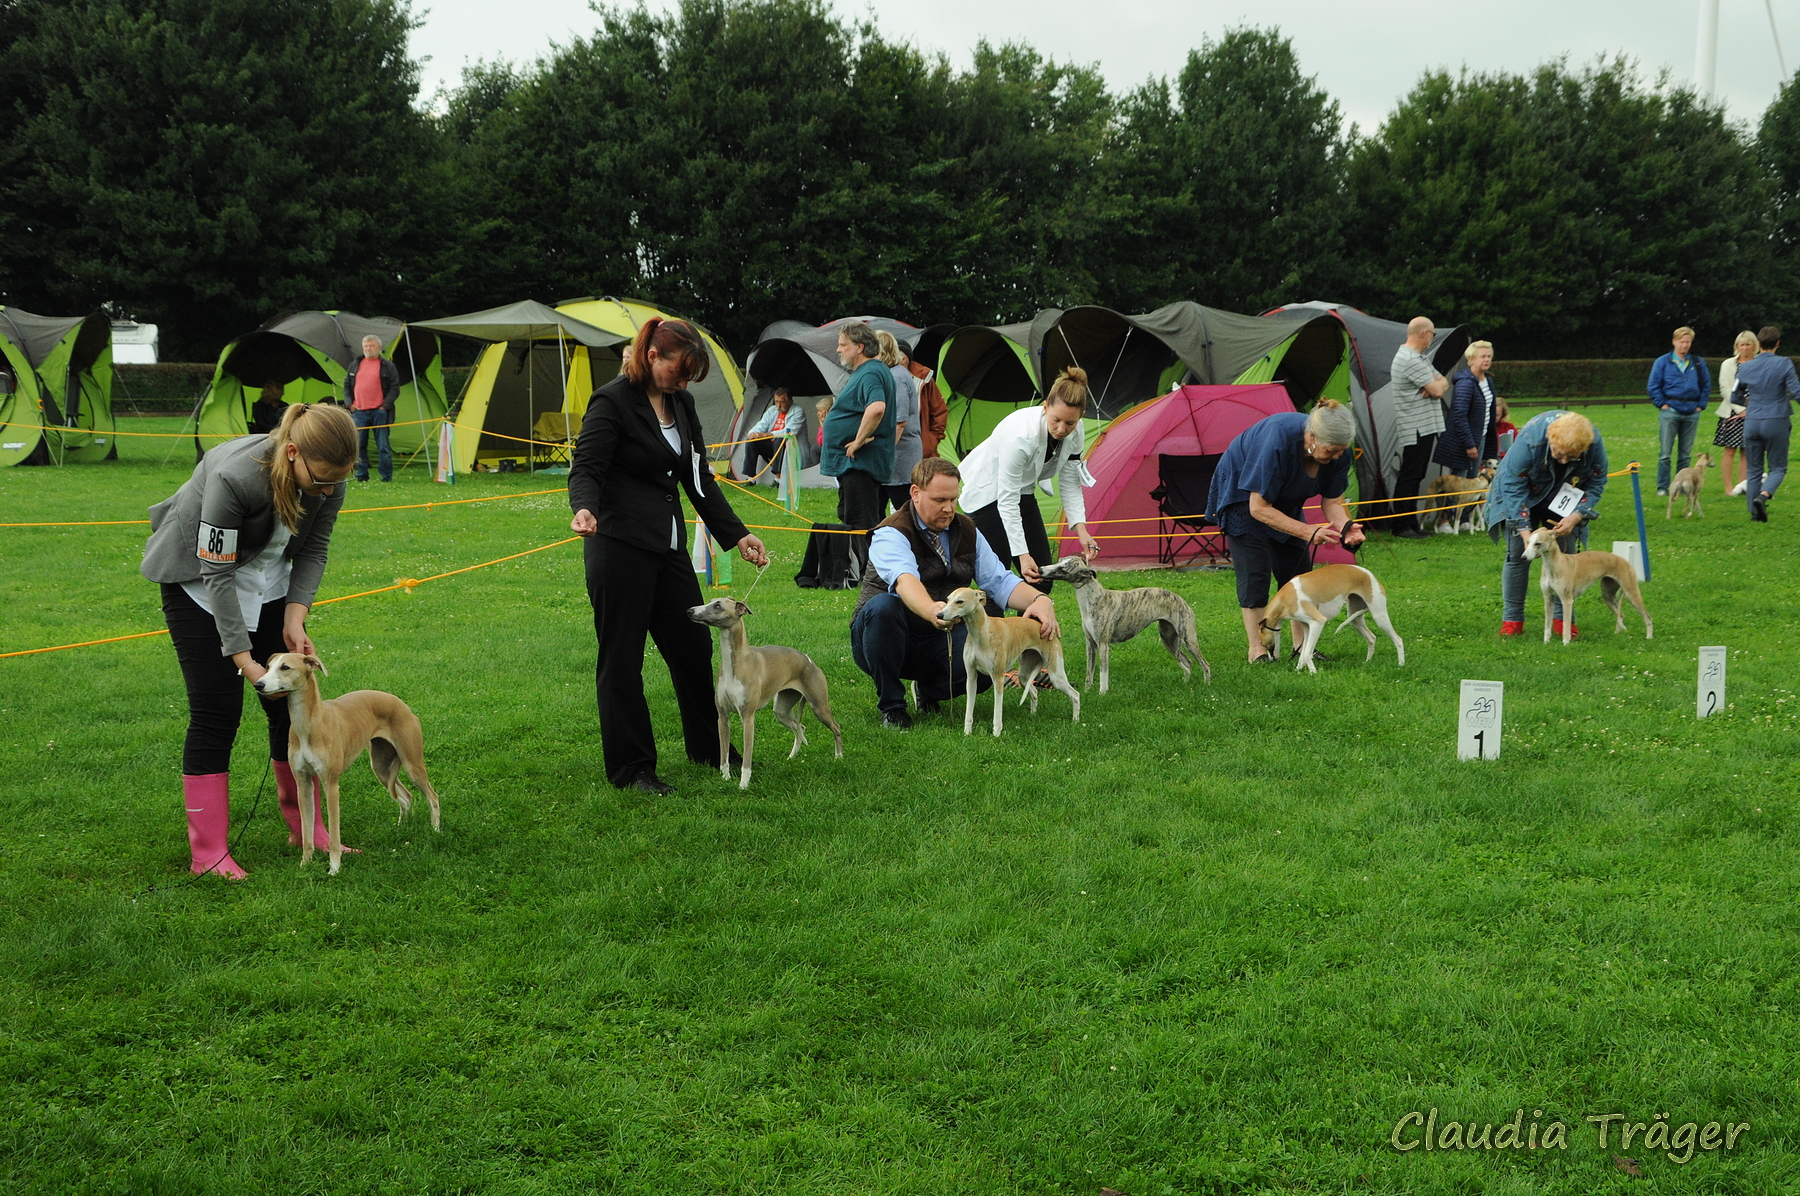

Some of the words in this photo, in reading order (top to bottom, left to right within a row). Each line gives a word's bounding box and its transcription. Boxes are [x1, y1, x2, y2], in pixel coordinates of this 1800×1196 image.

[1558, 495, 1572, 511] 91
[208, 527, 225, 554] 86
[1706, 690, 1717, 718] 2
[1466, 717, 1496, 728] WRV
[1474, 730, 1484, 760] 1
